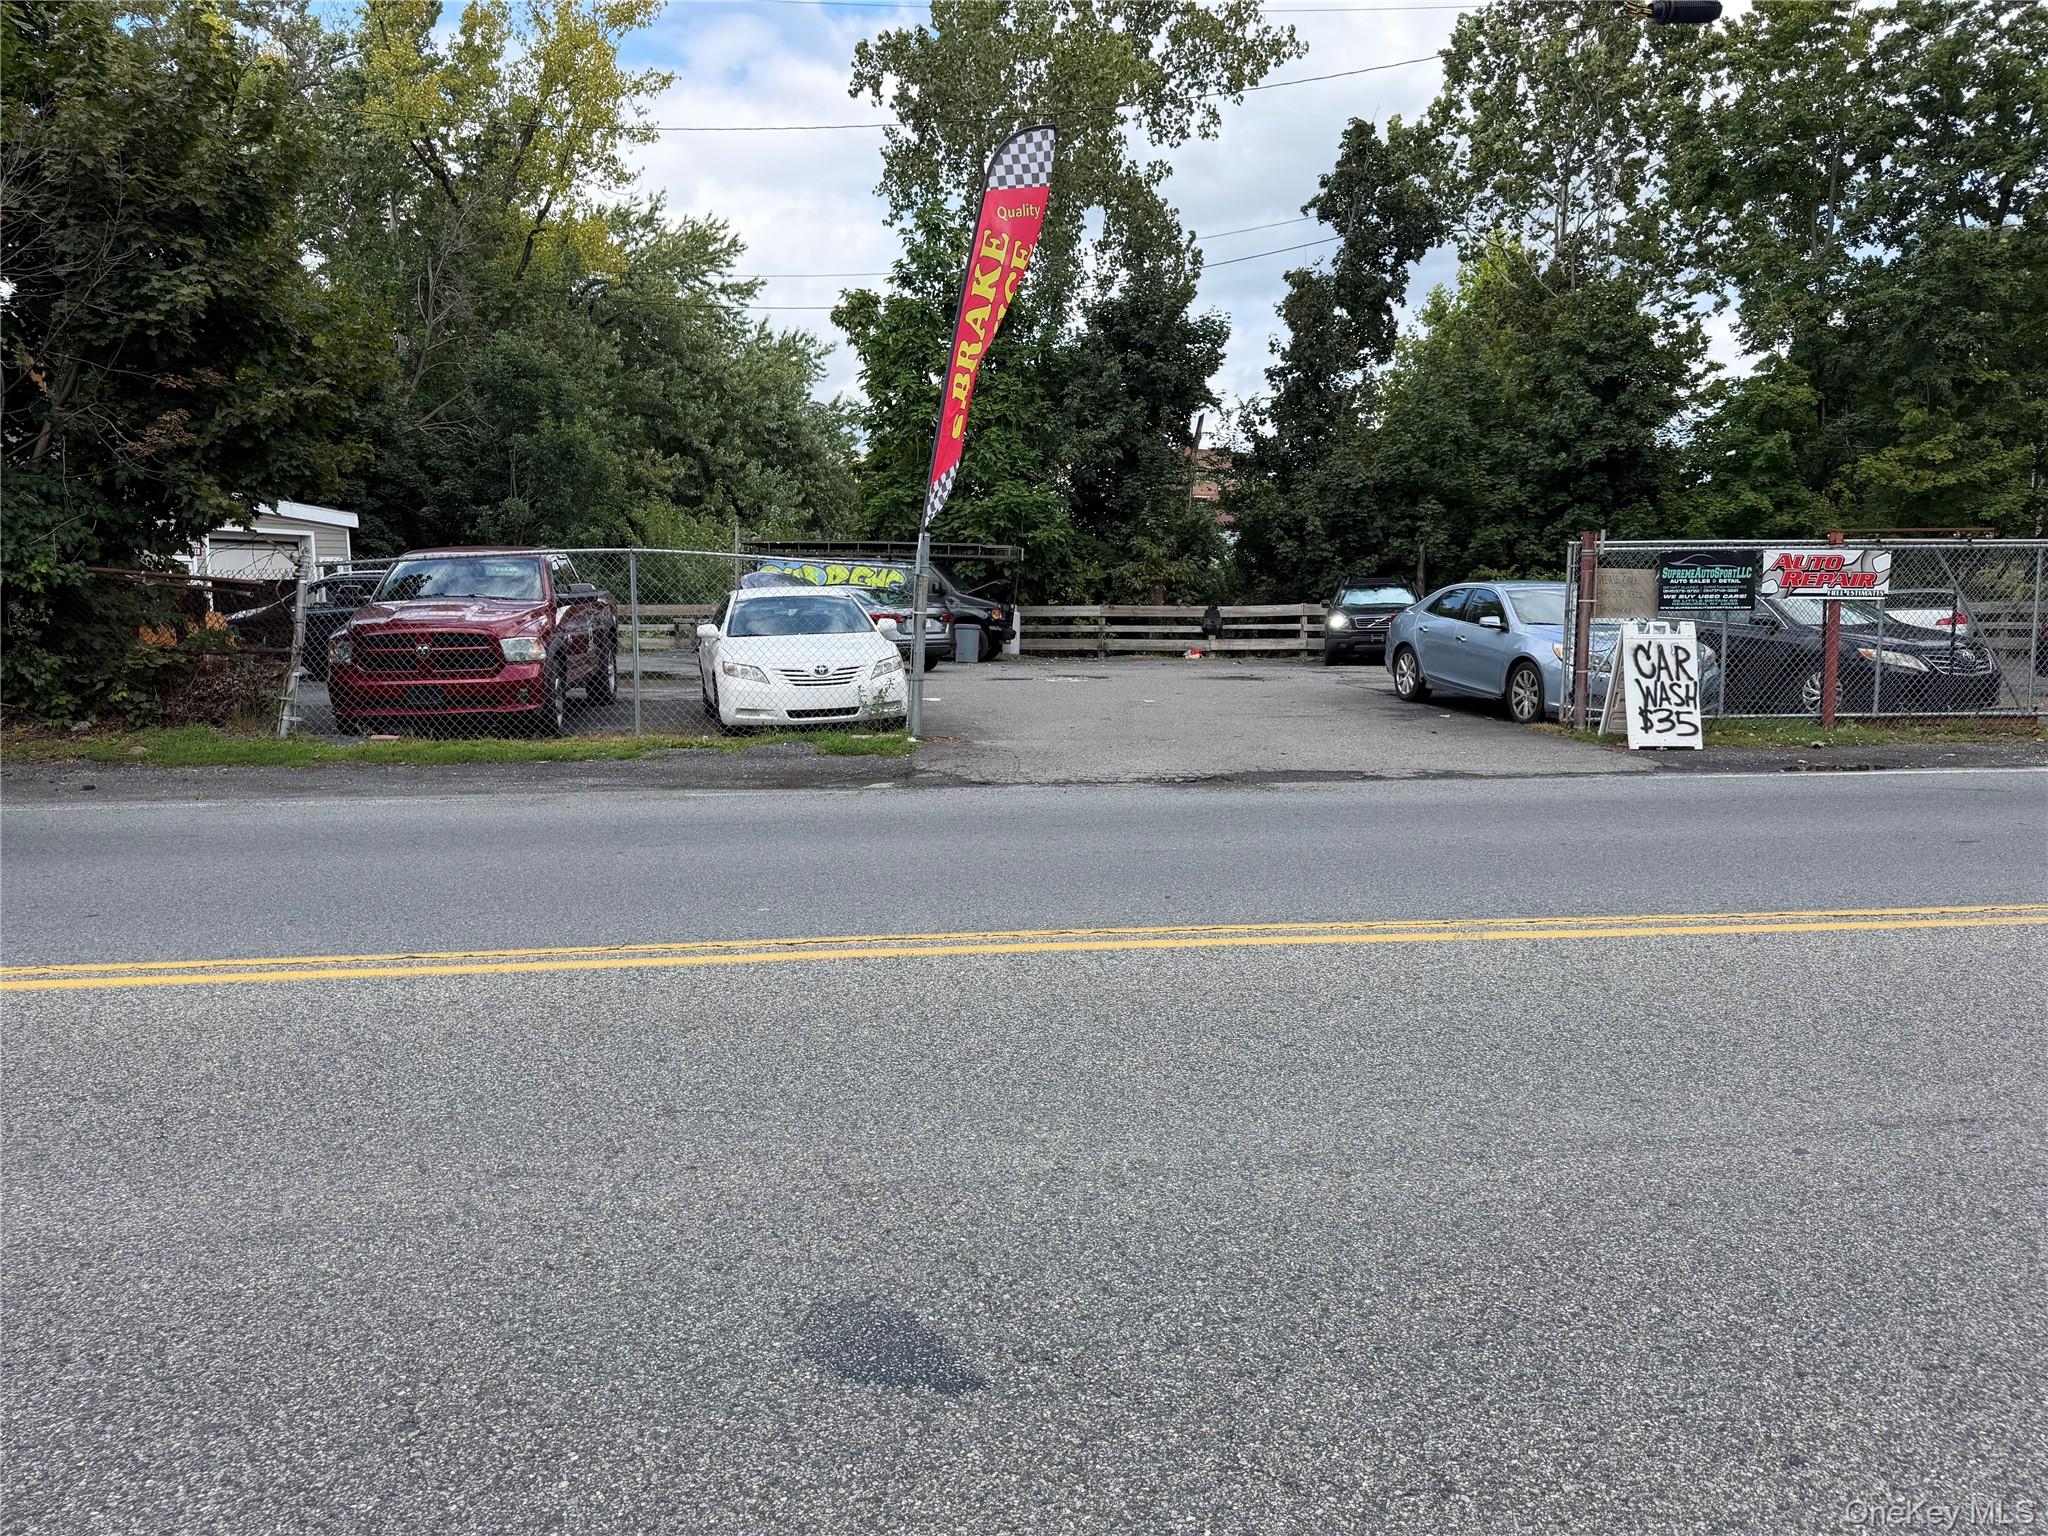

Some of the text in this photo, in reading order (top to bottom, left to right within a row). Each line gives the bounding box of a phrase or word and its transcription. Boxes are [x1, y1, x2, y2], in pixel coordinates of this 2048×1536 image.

[997, 203, 1041, 221] Quality
[952, 229, 1009, 410] BRAKE
[1770, 553, 1845, 571] AUTO
[1780, 569, 1877, 588] REPAIR
[1633, 640, 1694, 681] CAR
[1635, 678, 1698, 711] WASH
[1638, 706, 1699, 736] $35
